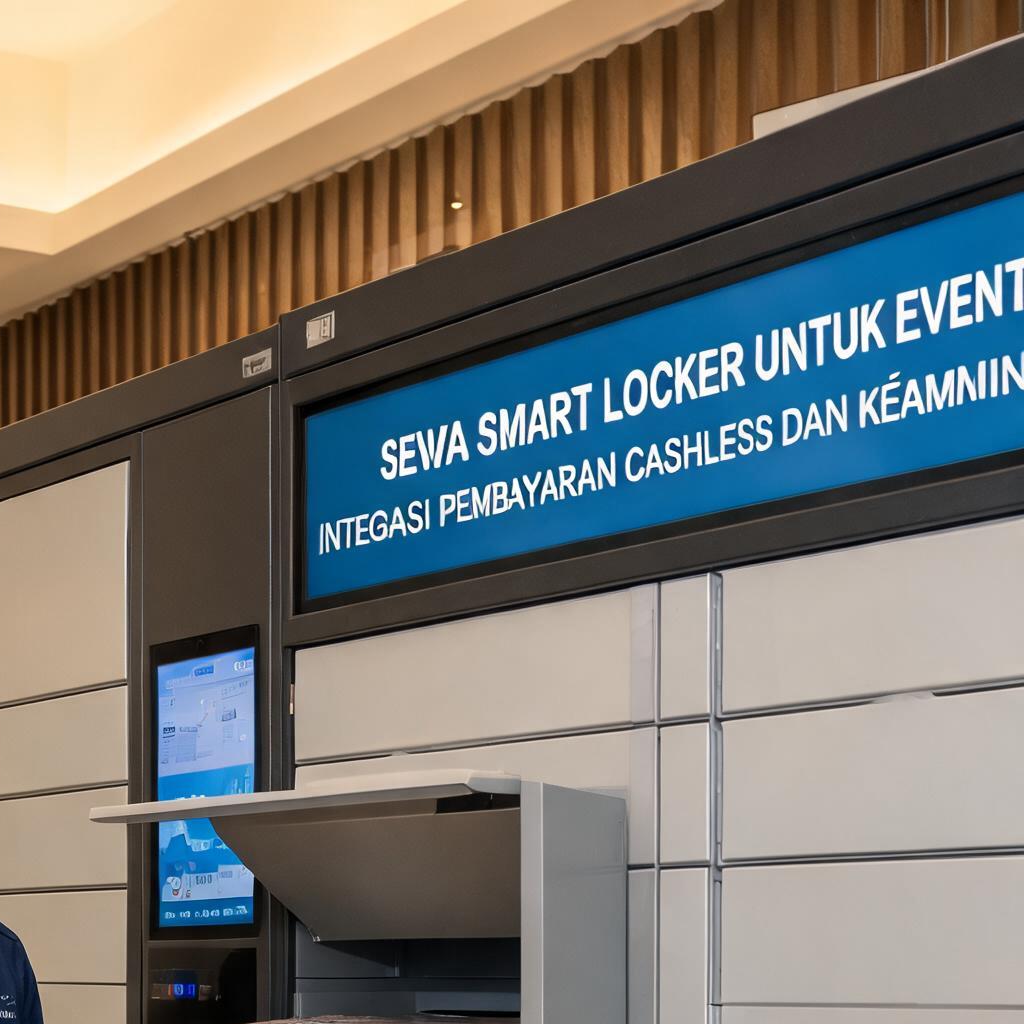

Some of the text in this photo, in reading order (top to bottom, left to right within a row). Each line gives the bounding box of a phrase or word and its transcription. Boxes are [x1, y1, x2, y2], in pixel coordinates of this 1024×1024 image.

[379, 257, 1024, 481] SEWA SMART LOCKER UNTUK EVENT
[318, 498, 430, 556] INTEGASI
[439, 450, 617, 528] PEMBAYARAN
[624, 406, 774, 483] CASHLESS
[781, 394, 848, 441] DAN
